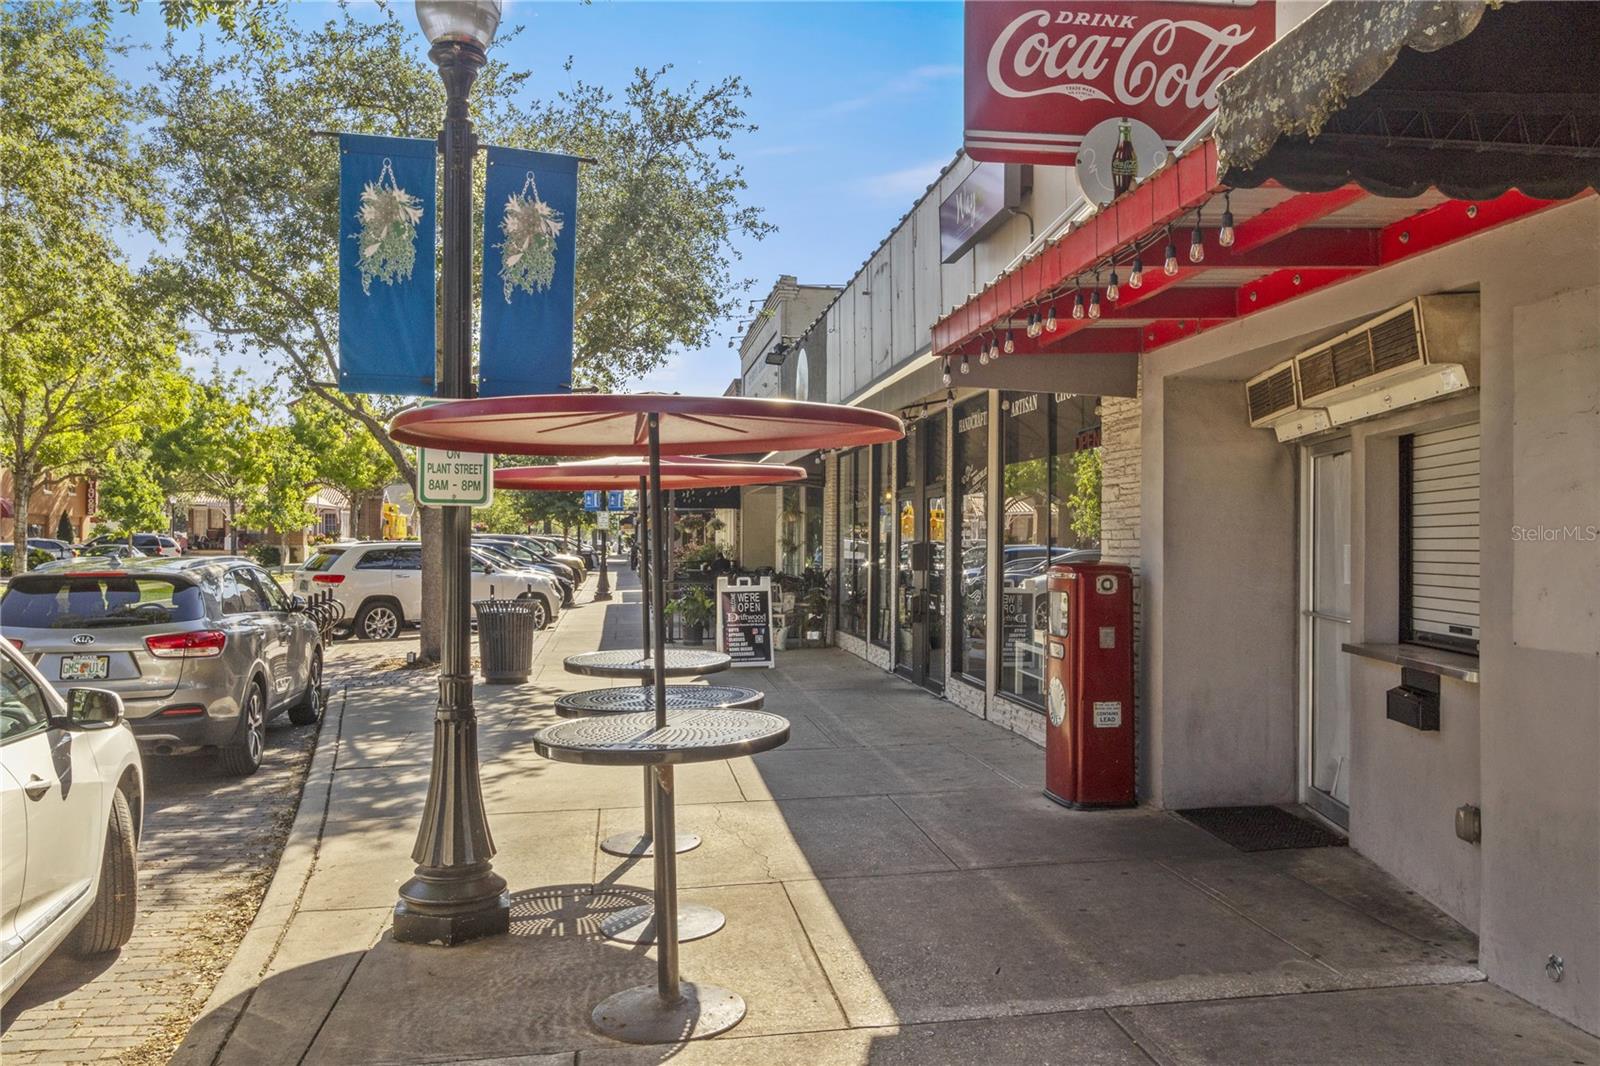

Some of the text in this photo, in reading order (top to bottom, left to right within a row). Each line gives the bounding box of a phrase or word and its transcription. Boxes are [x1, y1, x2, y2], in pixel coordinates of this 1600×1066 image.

[1055, 11, 1138, 29] DRINK
[1010, 394, 1038, 417] ARTISAN
[446, 451, 460, 459] ON
[427, 463, 483, 475] PLANT STREET
[428, 479, 449, 491] 8AM
[461, 480, 481, 491] 8PM
[737, 592, 760, 602] WE'RE
[737, 602, 761, 612] OPEN
[727, 612, 767, 623] Driftwood
